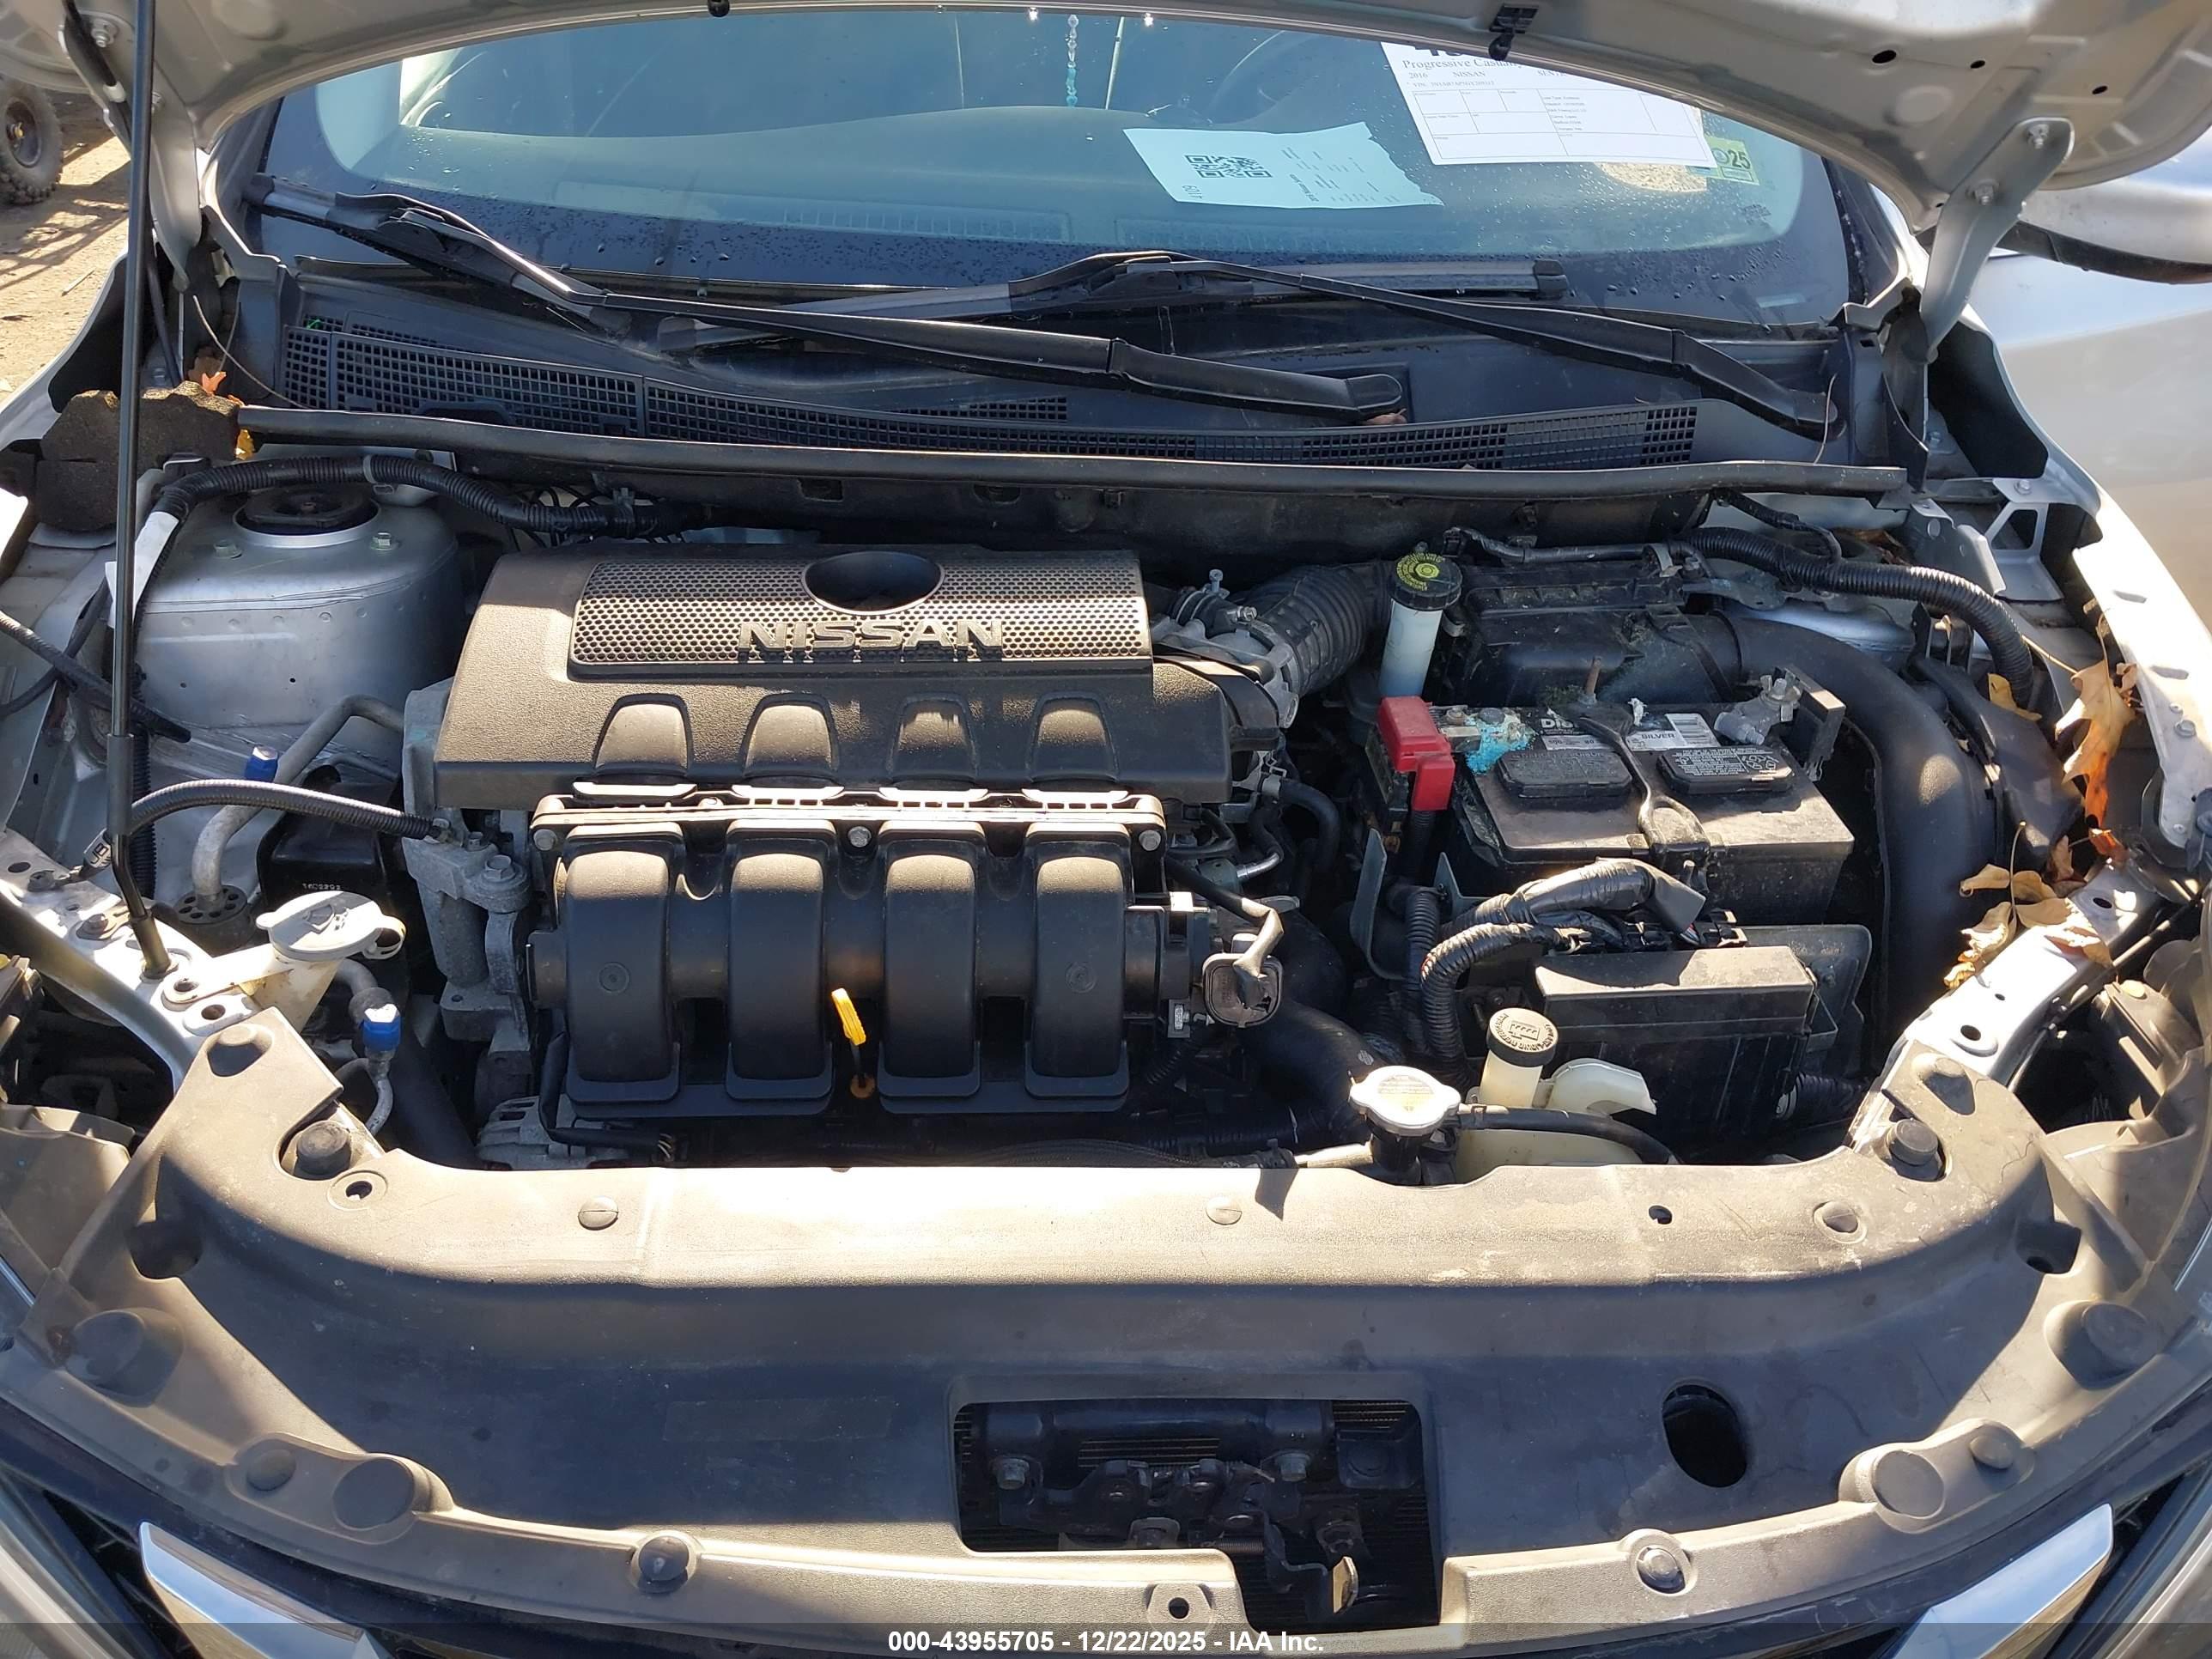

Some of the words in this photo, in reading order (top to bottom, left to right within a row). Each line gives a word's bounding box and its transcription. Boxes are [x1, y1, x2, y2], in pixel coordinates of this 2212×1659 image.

[1402, 58, 1470, 70] Progressive
[1728, 149, 1751, 169] 25
[738, 620, 1003, 650] NISSAN
